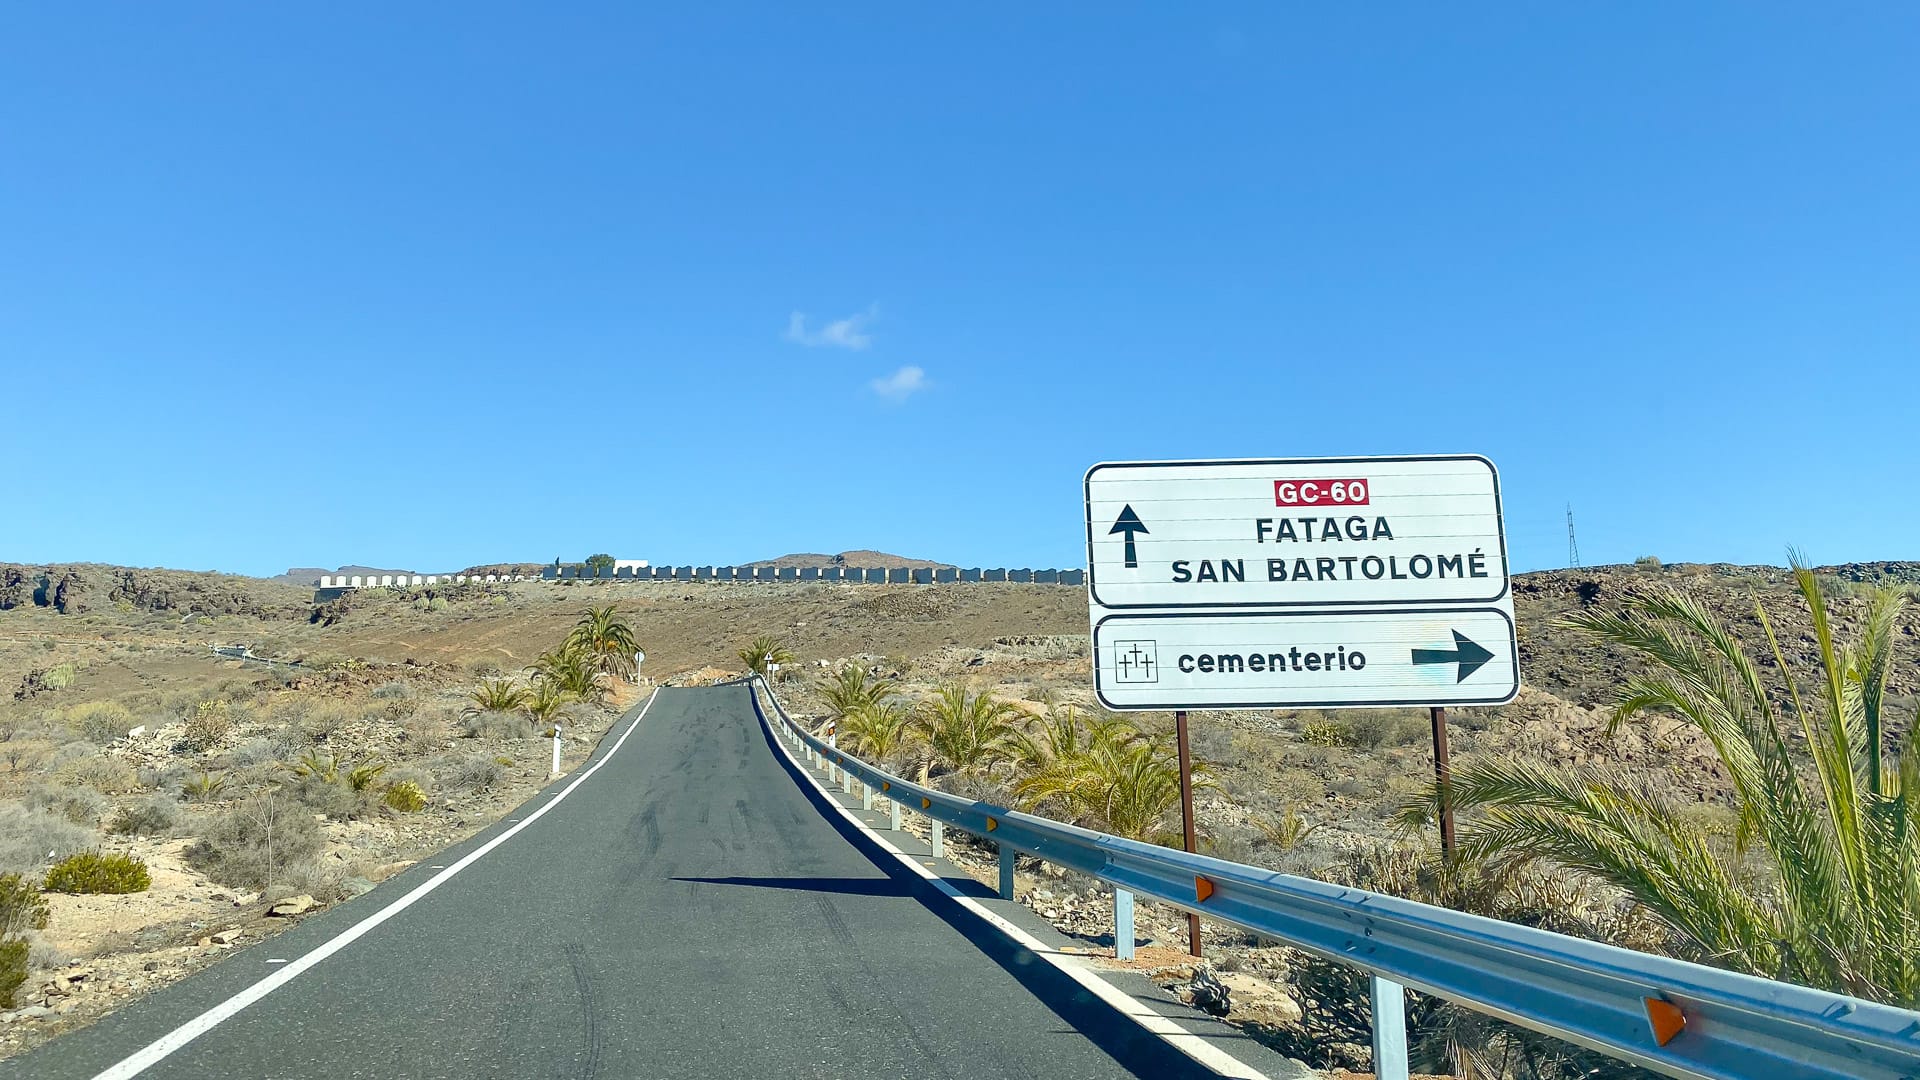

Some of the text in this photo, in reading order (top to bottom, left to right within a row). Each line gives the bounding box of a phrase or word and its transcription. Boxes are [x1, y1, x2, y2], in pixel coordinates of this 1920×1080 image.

[1277, 481, 1367, 504] GC-60
[1256, 516, 1394, 543] FATAGA
[1172, 548, 1488, 583] SAN BARTOLOMÉ
[1178, 645, 1366, 674] cementerio
